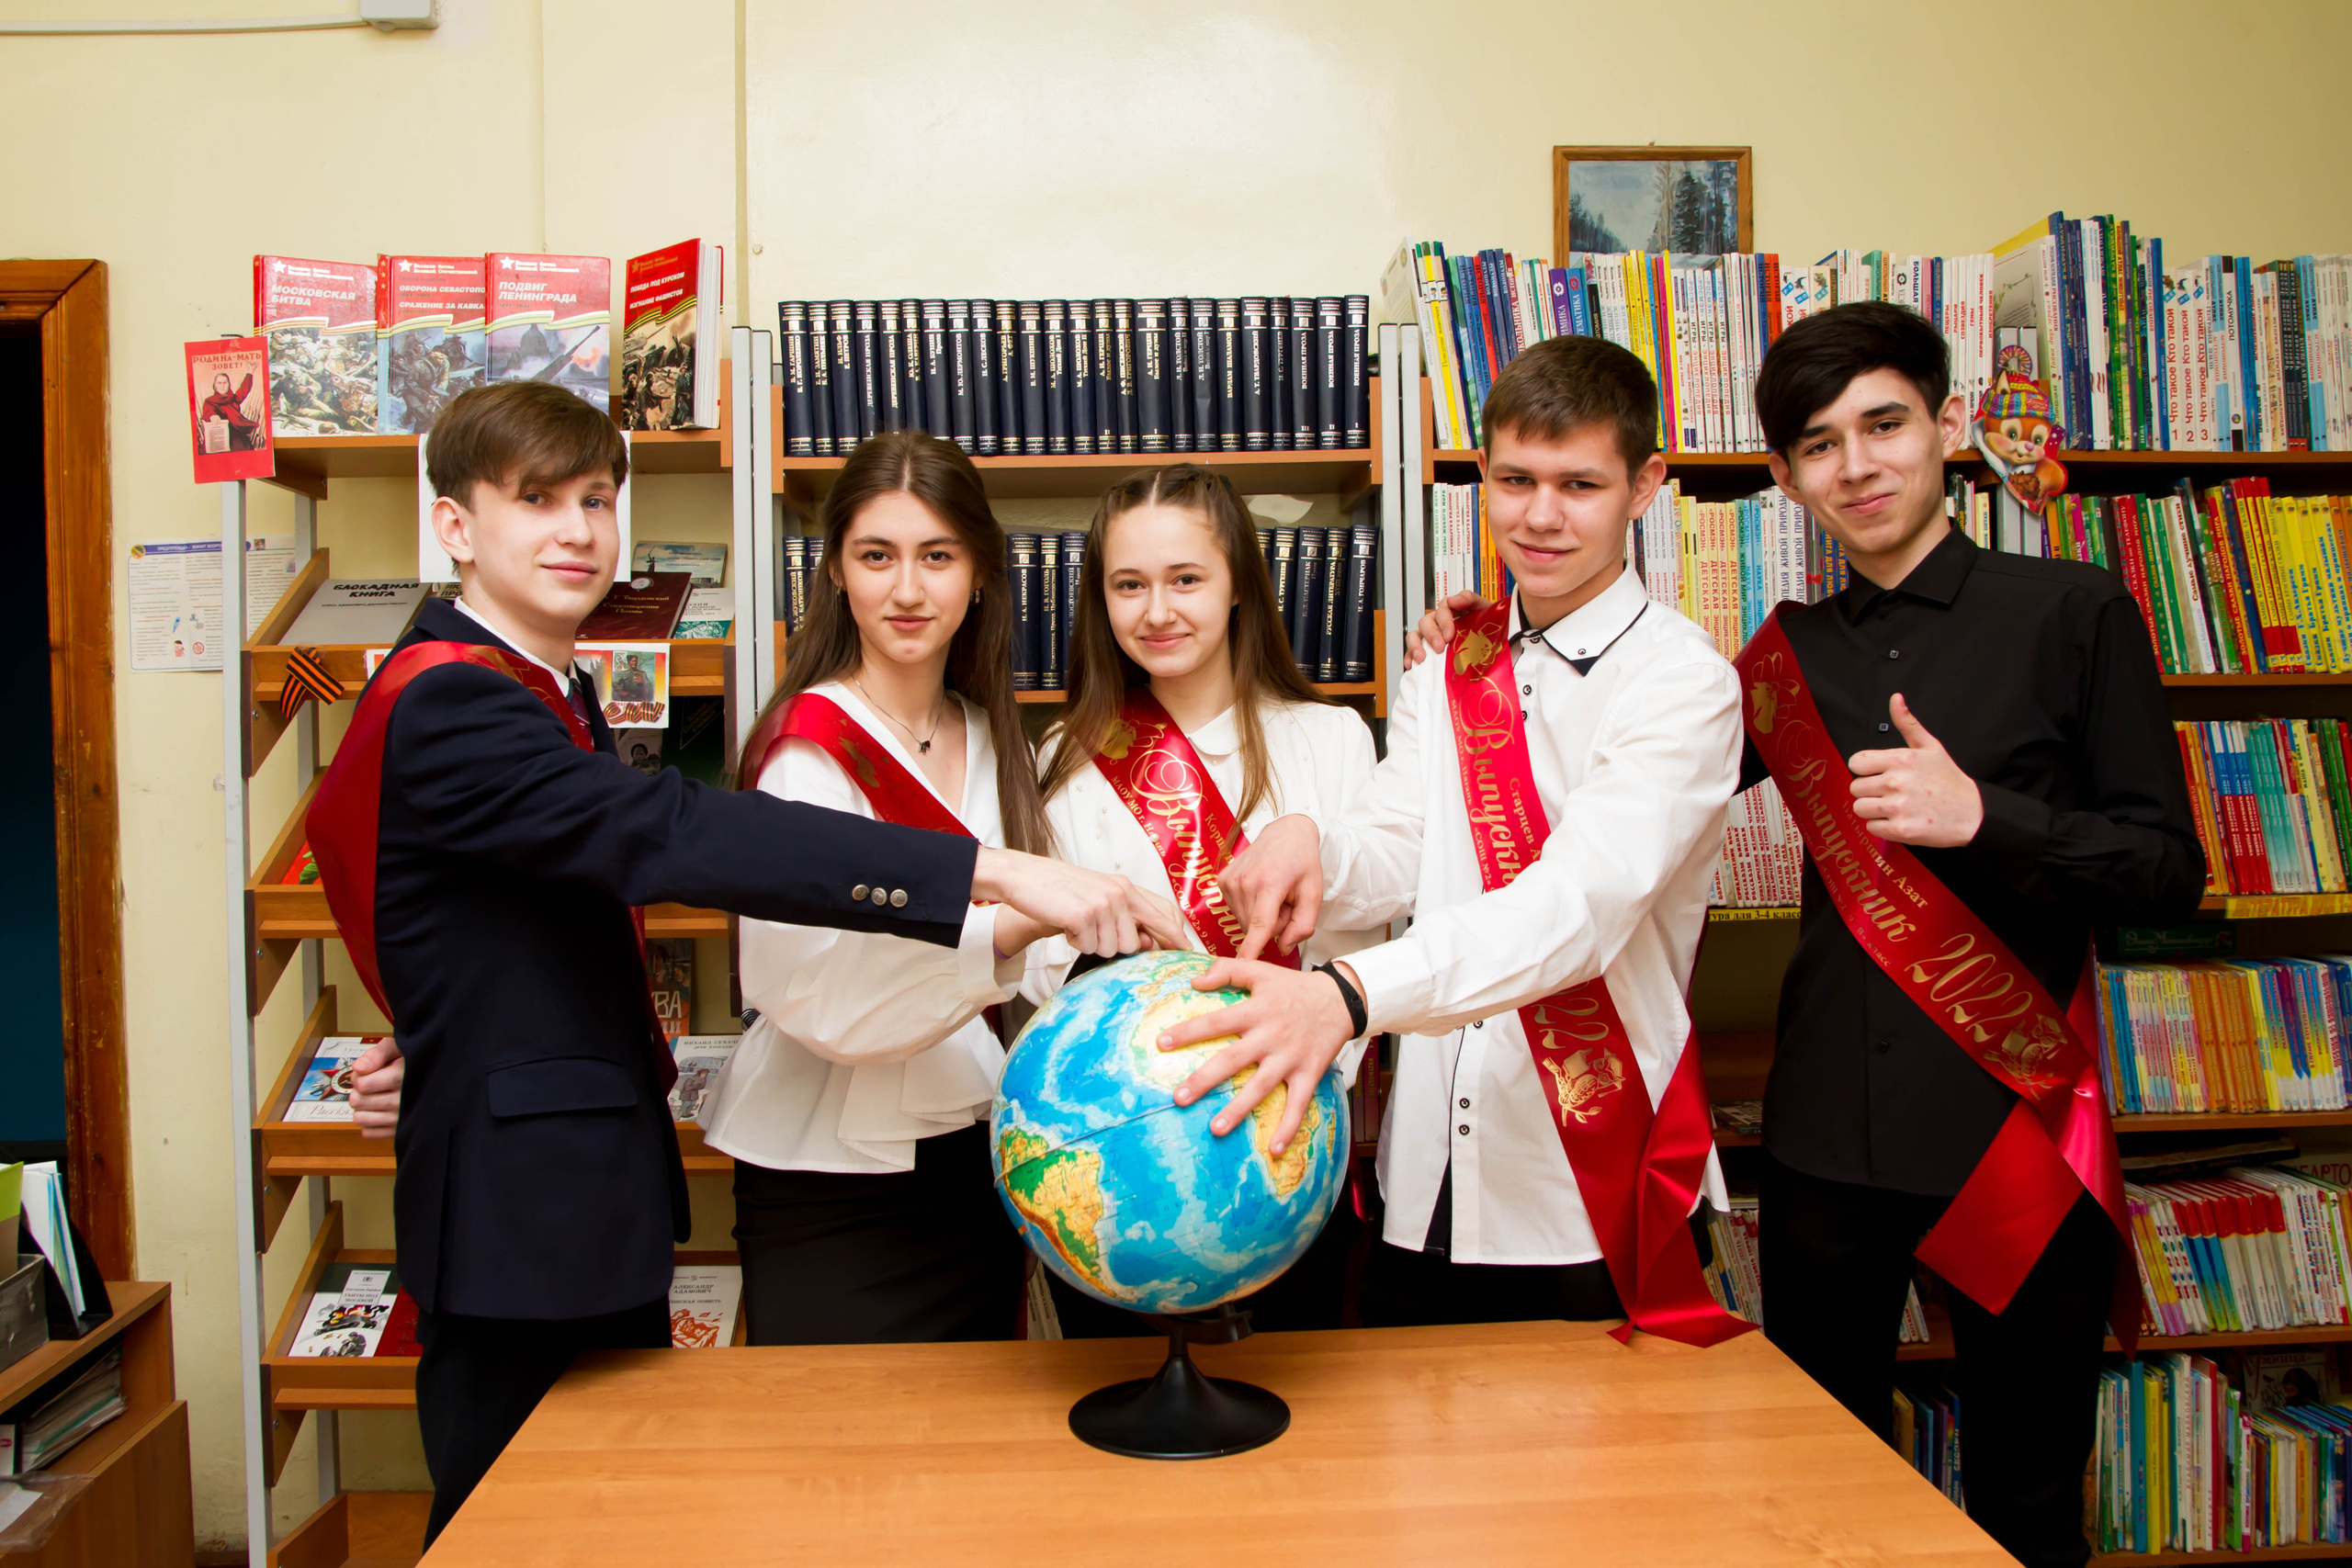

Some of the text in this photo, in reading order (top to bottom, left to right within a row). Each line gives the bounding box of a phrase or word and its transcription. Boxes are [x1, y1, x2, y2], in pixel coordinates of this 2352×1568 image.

[271, 285, 356, 300] МОСКОВСКАЯ
[271, 295, 311, 307] БИТВА
[498, 291, 577, 303] ЛЕНИНГРАДА
[499, 282, 548, 291] ПОДВИГ
[629, 272, 685, 293] ПОБЕДА ПОД КУРСКОМ
[629, 288, 684, 310] ИЗГНАНИЕ ФАШИСТОВ
[2196, 309, 2204, 341] такой
[193, 353, 262, 364] РОДИНА-МАТЬ
[787, 335, 796, 366] ГАРШИН
[794, 334, 802, 378] КОРОЛЕНКО
[842, 334, 851, 362] ПЕТРОВ
[956, 333, 964, 377] ЛЕРМОНТОВ
[979, 333, 988, 361] ЛЕСКОВ
[1117, 333, 1125, 378] ПИСЕМСКИЙ
[211, 362, 243, 371] ЗОВЕТ!
[864, 334, 874, 407] ДЕРЕВЕНСКАЯ ПРОЗА
[889, 359, 899, 408] ДЕРЕВЕНСКАЯ
[1692, 351, 1702, 415] ЭНЦИКЛОПЕДИЯ
[1721, 350, 1730, 415] ЭНЦИКЛОПЕДИЯ
[2165, 309, 2177, 423] Что такое Кто такой
[2181, 310, 2193, 424] Что такое Кто такой
[2199, 401, 2208, 423] Что
[1778, 495, 1788, 568] ЖИВОЙ ПРИРОДЫ
[2120, 505, 2138, 590] СКАЗКИ ТЕЛЕФОНУ
[1793, 537, 1804, 568] ЖИВОЙ
[2175, 503, 2199, 601] Самые лучшие стихи
[333, 582, 420, 591] БЛОКАДНАЯ
[790, 571, 798, 616] ЖУКОВСКИЙ
[1278, 562, 1286, 596] ТУРГЕНЕВ
[1328, 560, 1336, 604] ЛИТЕРАТУРА
[1358, 559, 1366, 596] ГОНЧАРОВ
[1701, 560, 1709, 610] ДЕТСКАЯ
[1720, 560, 1728, 609] ДЕТСКАЯ
[2132, 514, 2159, 656] ЗОЛОТЫЕ СКАЗКИ НАРОДОВ МИРА
[2214, 516, 2246, 655] ЗОЛОТЫЕ НАРОДОВ МИРА
[2301, 634, 2312, 666] Сказки
[2312, 634, 2323, 666] Сказки
[1451, 699, 1463, 735] МАОУ
[1456, 736, 1465, 754] МО
[1509, 777, 1535, 844] Старцев
[1111, 775, 1131, 801] МАОУ
[1130, 800, 1143, 816] МО
[1171, 877, 1191, 910] «СОШ
[1474, 827, 1487, 861] «СОШ
[1777, 719, 1917, 942] Выпускник
[1741, 827, 1757, 901] РАССКАЗЫ БИАНКИ
[1767, 854, 1778, 902] ПРИКЛЮЧЕНИЯ
[1777, 864, 1786, 899] ВРЕМЕНА
[1893, 876, 1928, 908] Азат
[1755, 910, 1770, 919] 3-4
[1904, 933, 2033, 1043] 2022
